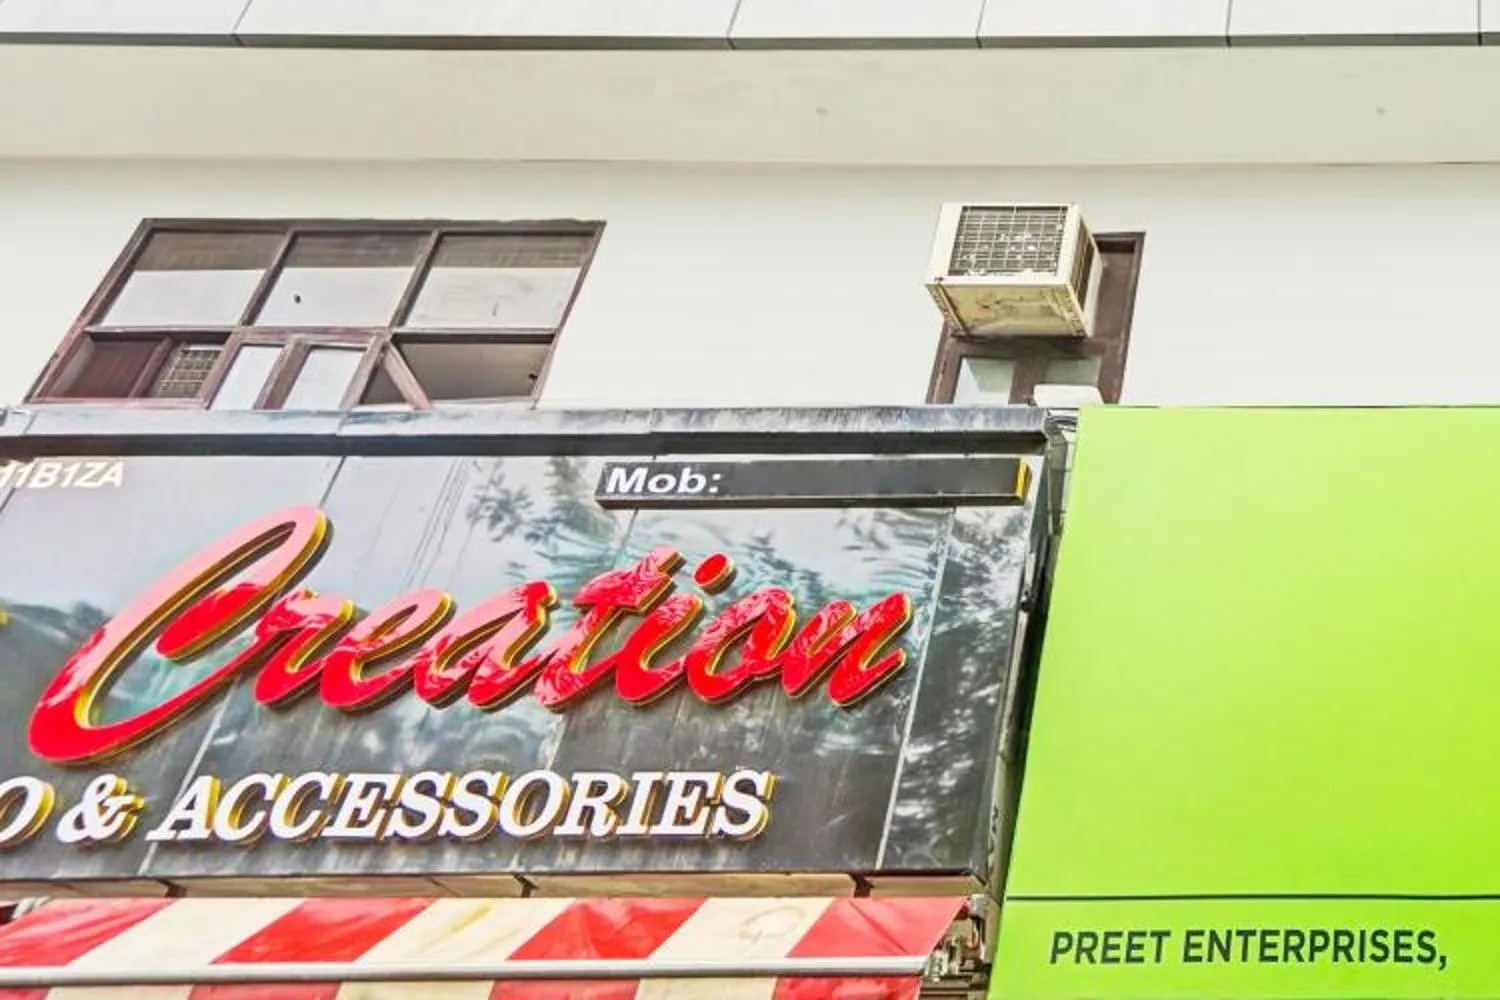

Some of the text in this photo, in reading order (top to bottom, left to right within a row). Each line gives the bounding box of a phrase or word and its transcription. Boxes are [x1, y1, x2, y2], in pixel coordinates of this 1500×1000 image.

[605, 467, 722, 494] Mob:
[28, 505, 913, 765] Creation
[56, 773, 144, 844] &
[146, 769, 776, 843] ACCESSORIES
[1049, 929, 1448, 970] PREET ENTERPRISES,
